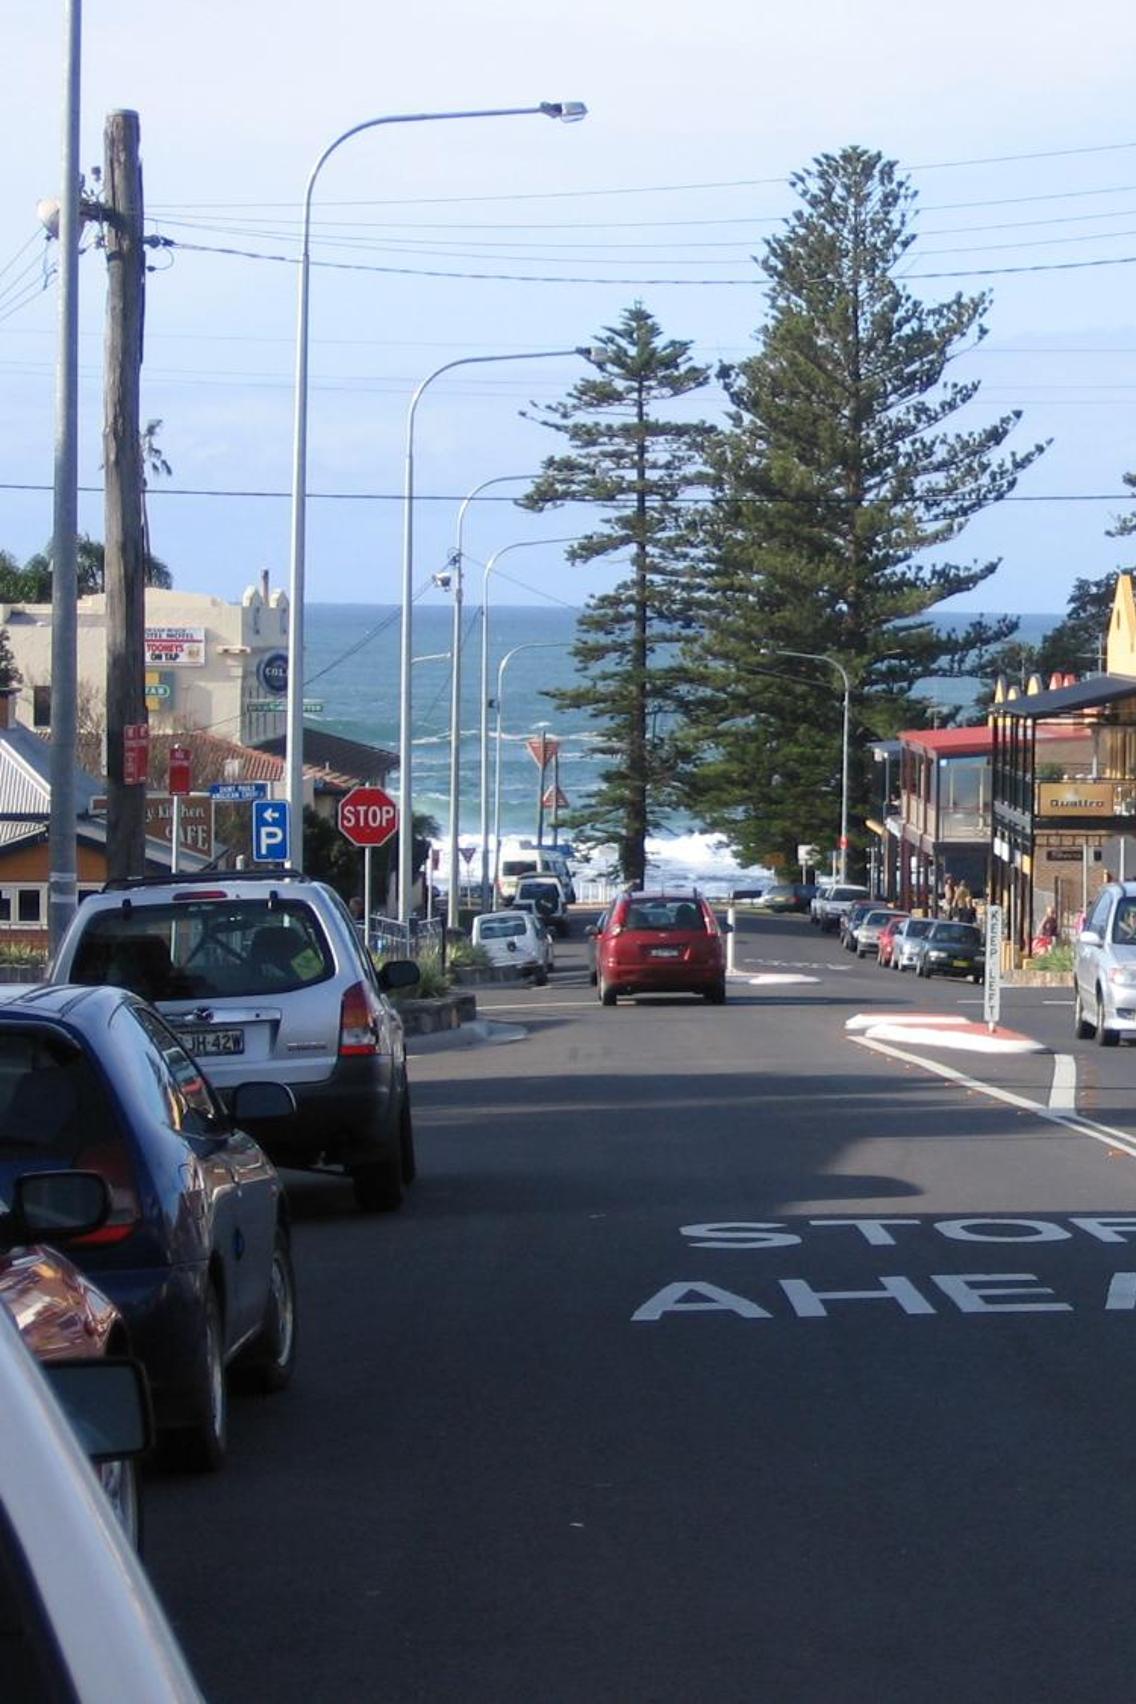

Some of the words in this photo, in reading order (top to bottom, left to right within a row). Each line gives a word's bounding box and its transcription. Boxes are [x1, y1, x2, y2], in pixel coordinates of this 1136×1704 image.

[343, 805, 395, 828] STOP
[1050, 799, 1104, 808] Quattro
[261, 826, 284, 855] P
[989, 910, 999, 958] KEEP
[988, 968, 996, 1015] LEFT
